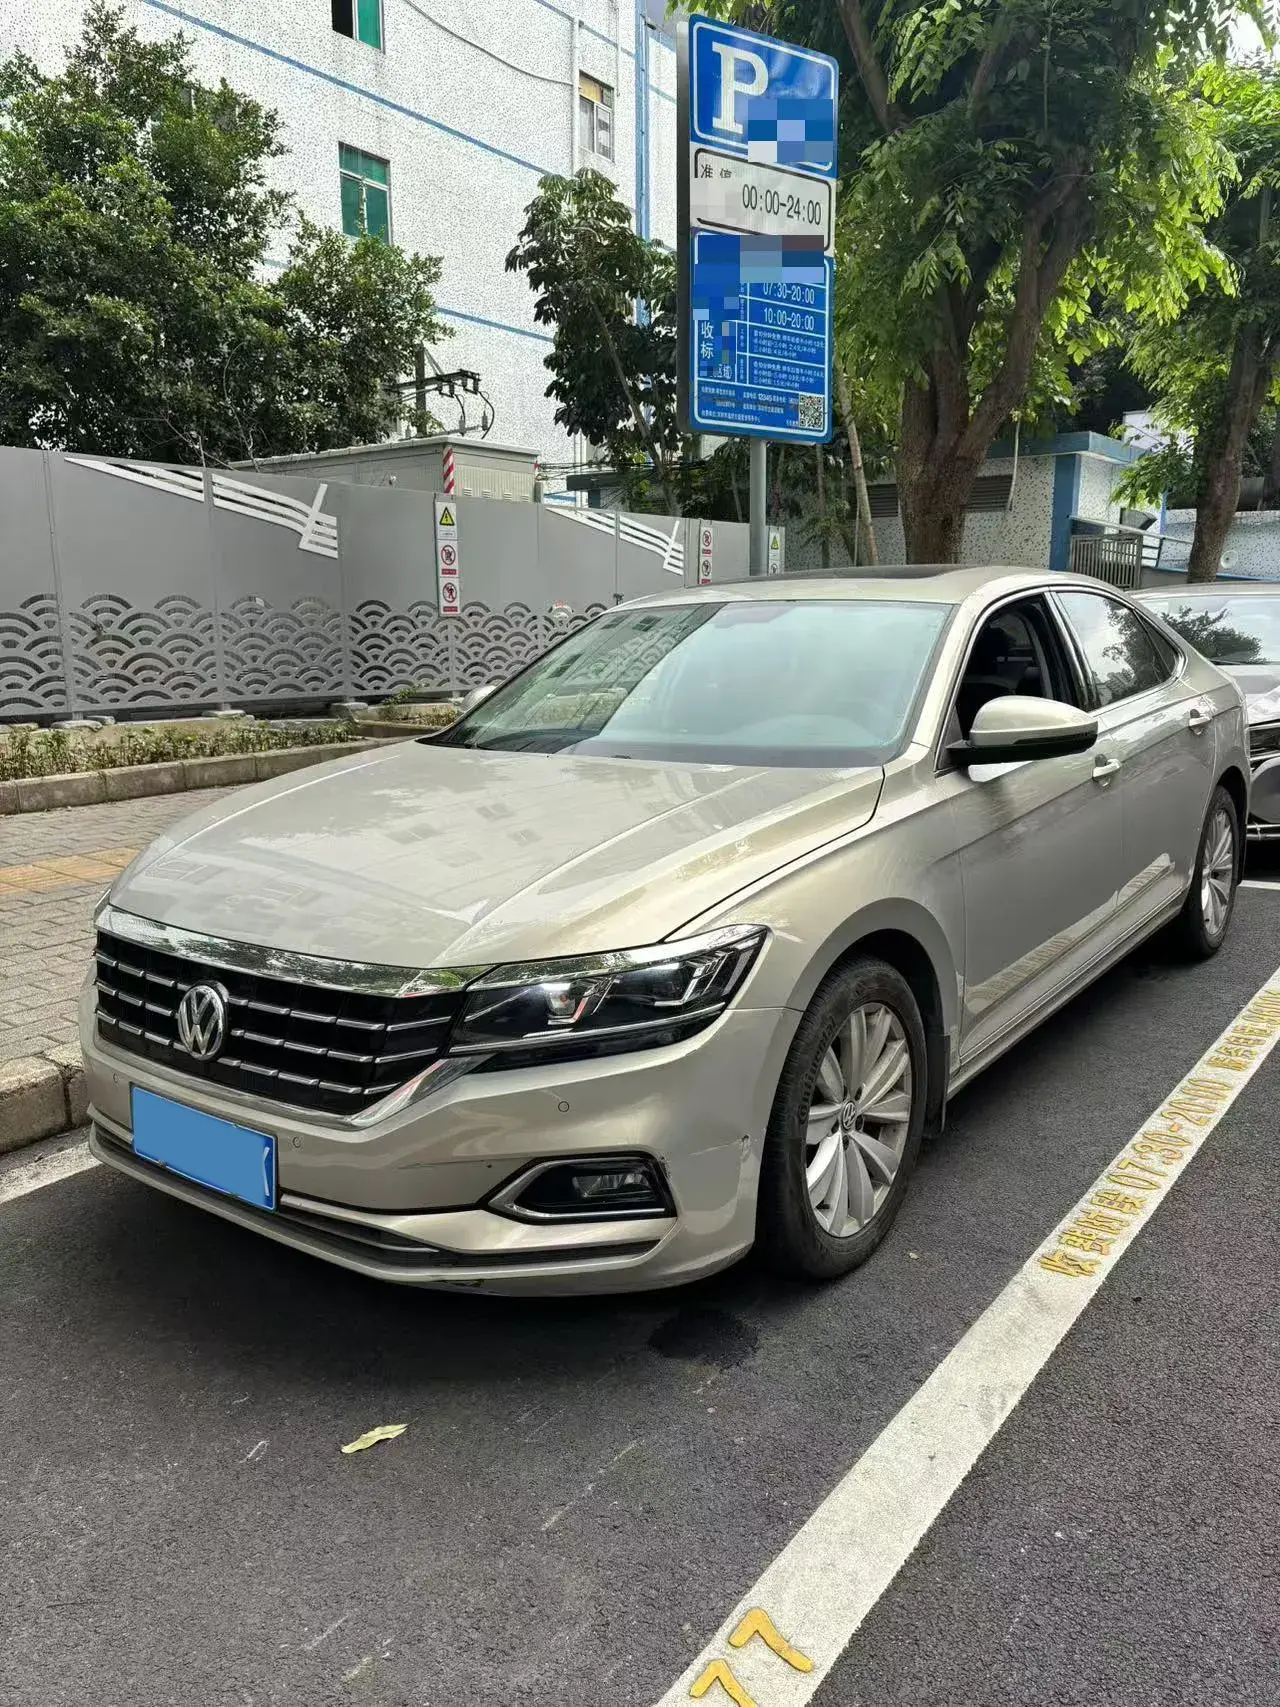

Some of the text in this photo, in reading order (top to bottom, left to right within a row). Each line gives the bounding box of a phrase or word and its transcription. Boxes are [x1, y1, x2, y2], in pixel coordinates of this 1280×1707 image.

[712, 41, 769, 134] P
[742, 184, 822, 225] 00:00-24:00
[763, 282, 815, 305] 07:30-20:00
[763, 307, 815, 331] 10:00-20:00
